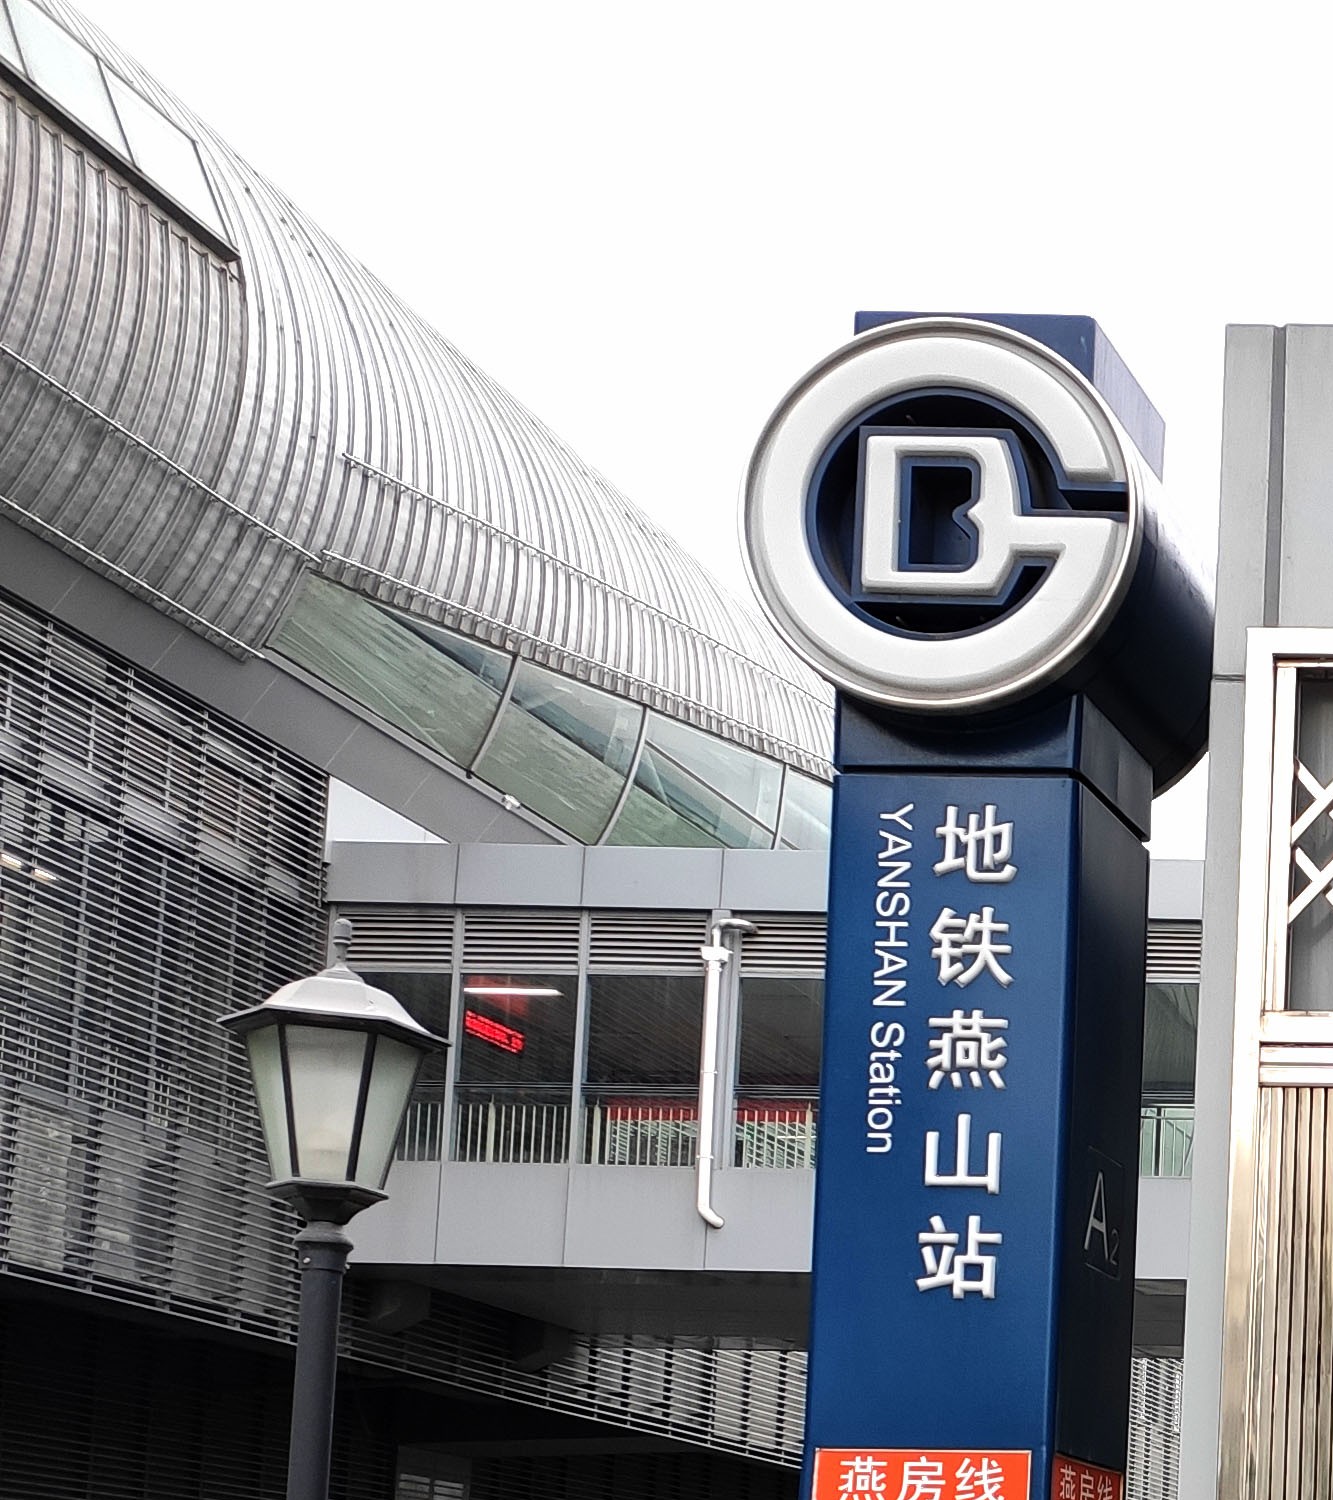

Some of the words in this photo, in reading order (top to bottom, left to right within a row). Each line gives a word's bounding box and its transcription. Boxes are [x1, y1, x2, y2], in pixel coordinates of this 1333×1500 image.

[872, 803, 915, 1007] YANSHAN
[866, 1021, 905, 1154] Station
[915, 804, 1018, 1300] 地铁燕山站
